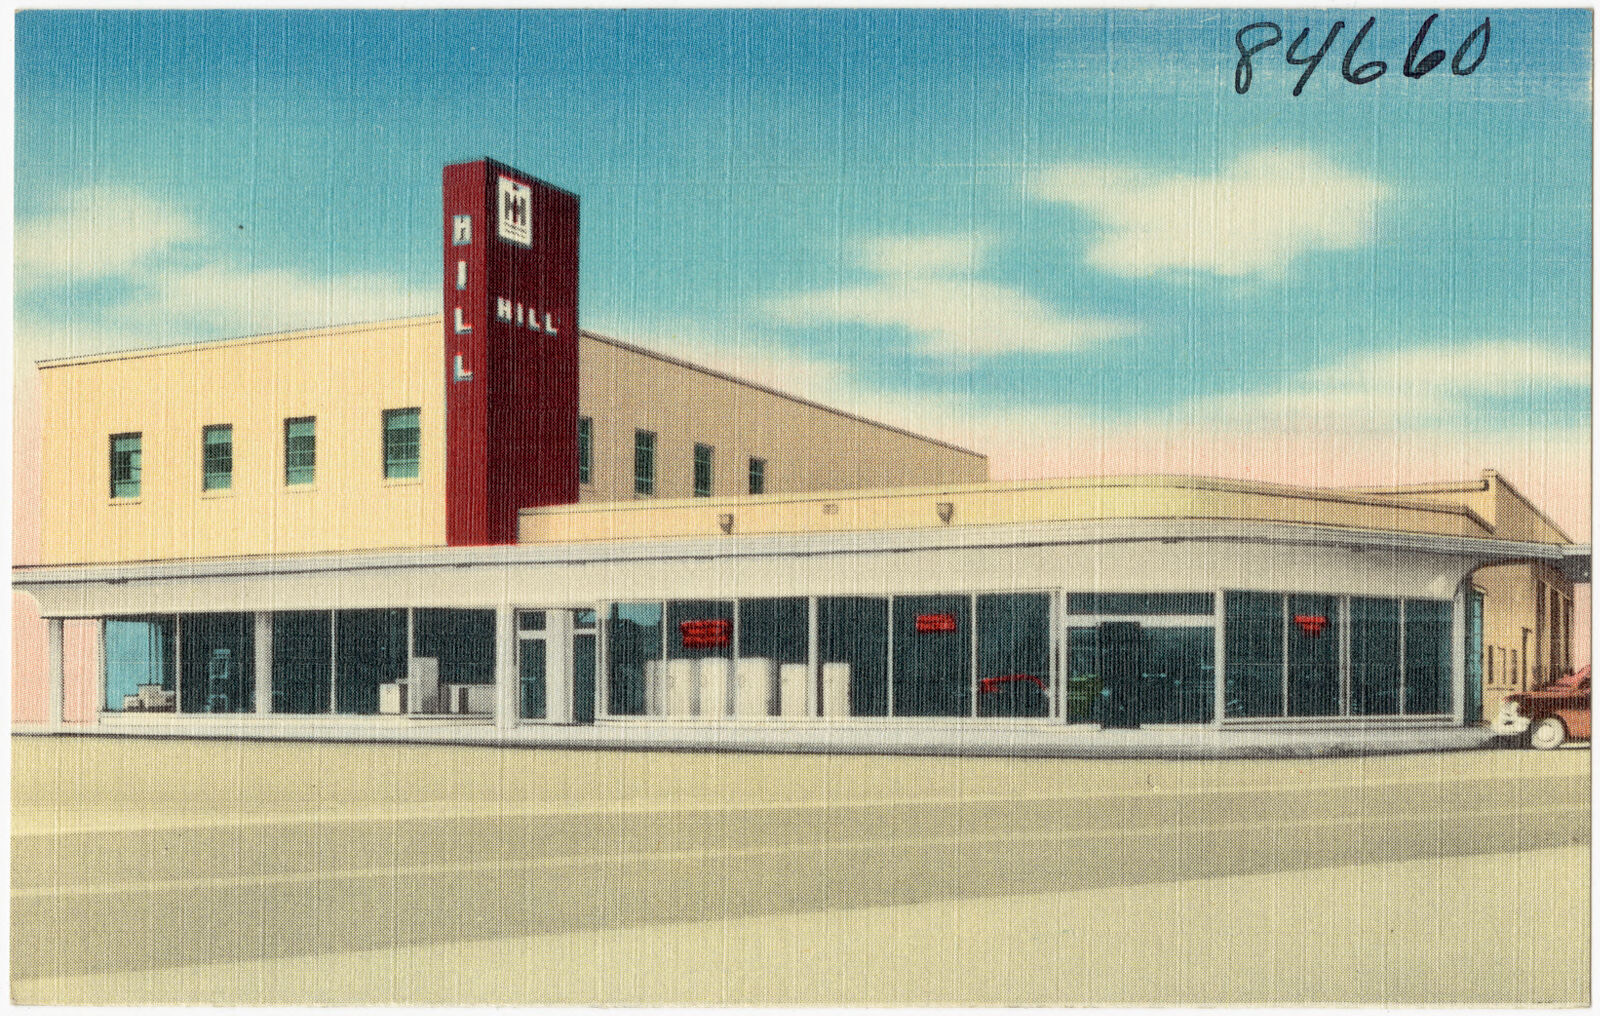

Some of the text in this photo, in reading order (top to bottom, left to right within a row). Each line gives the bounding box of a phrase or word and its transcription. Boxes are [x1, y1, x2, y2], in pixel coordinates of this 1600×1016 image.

[1235, 13, 1491, 96] 84660
[452, 214, 473, 383] HILL
[496, 296, 559, 336] HILL
